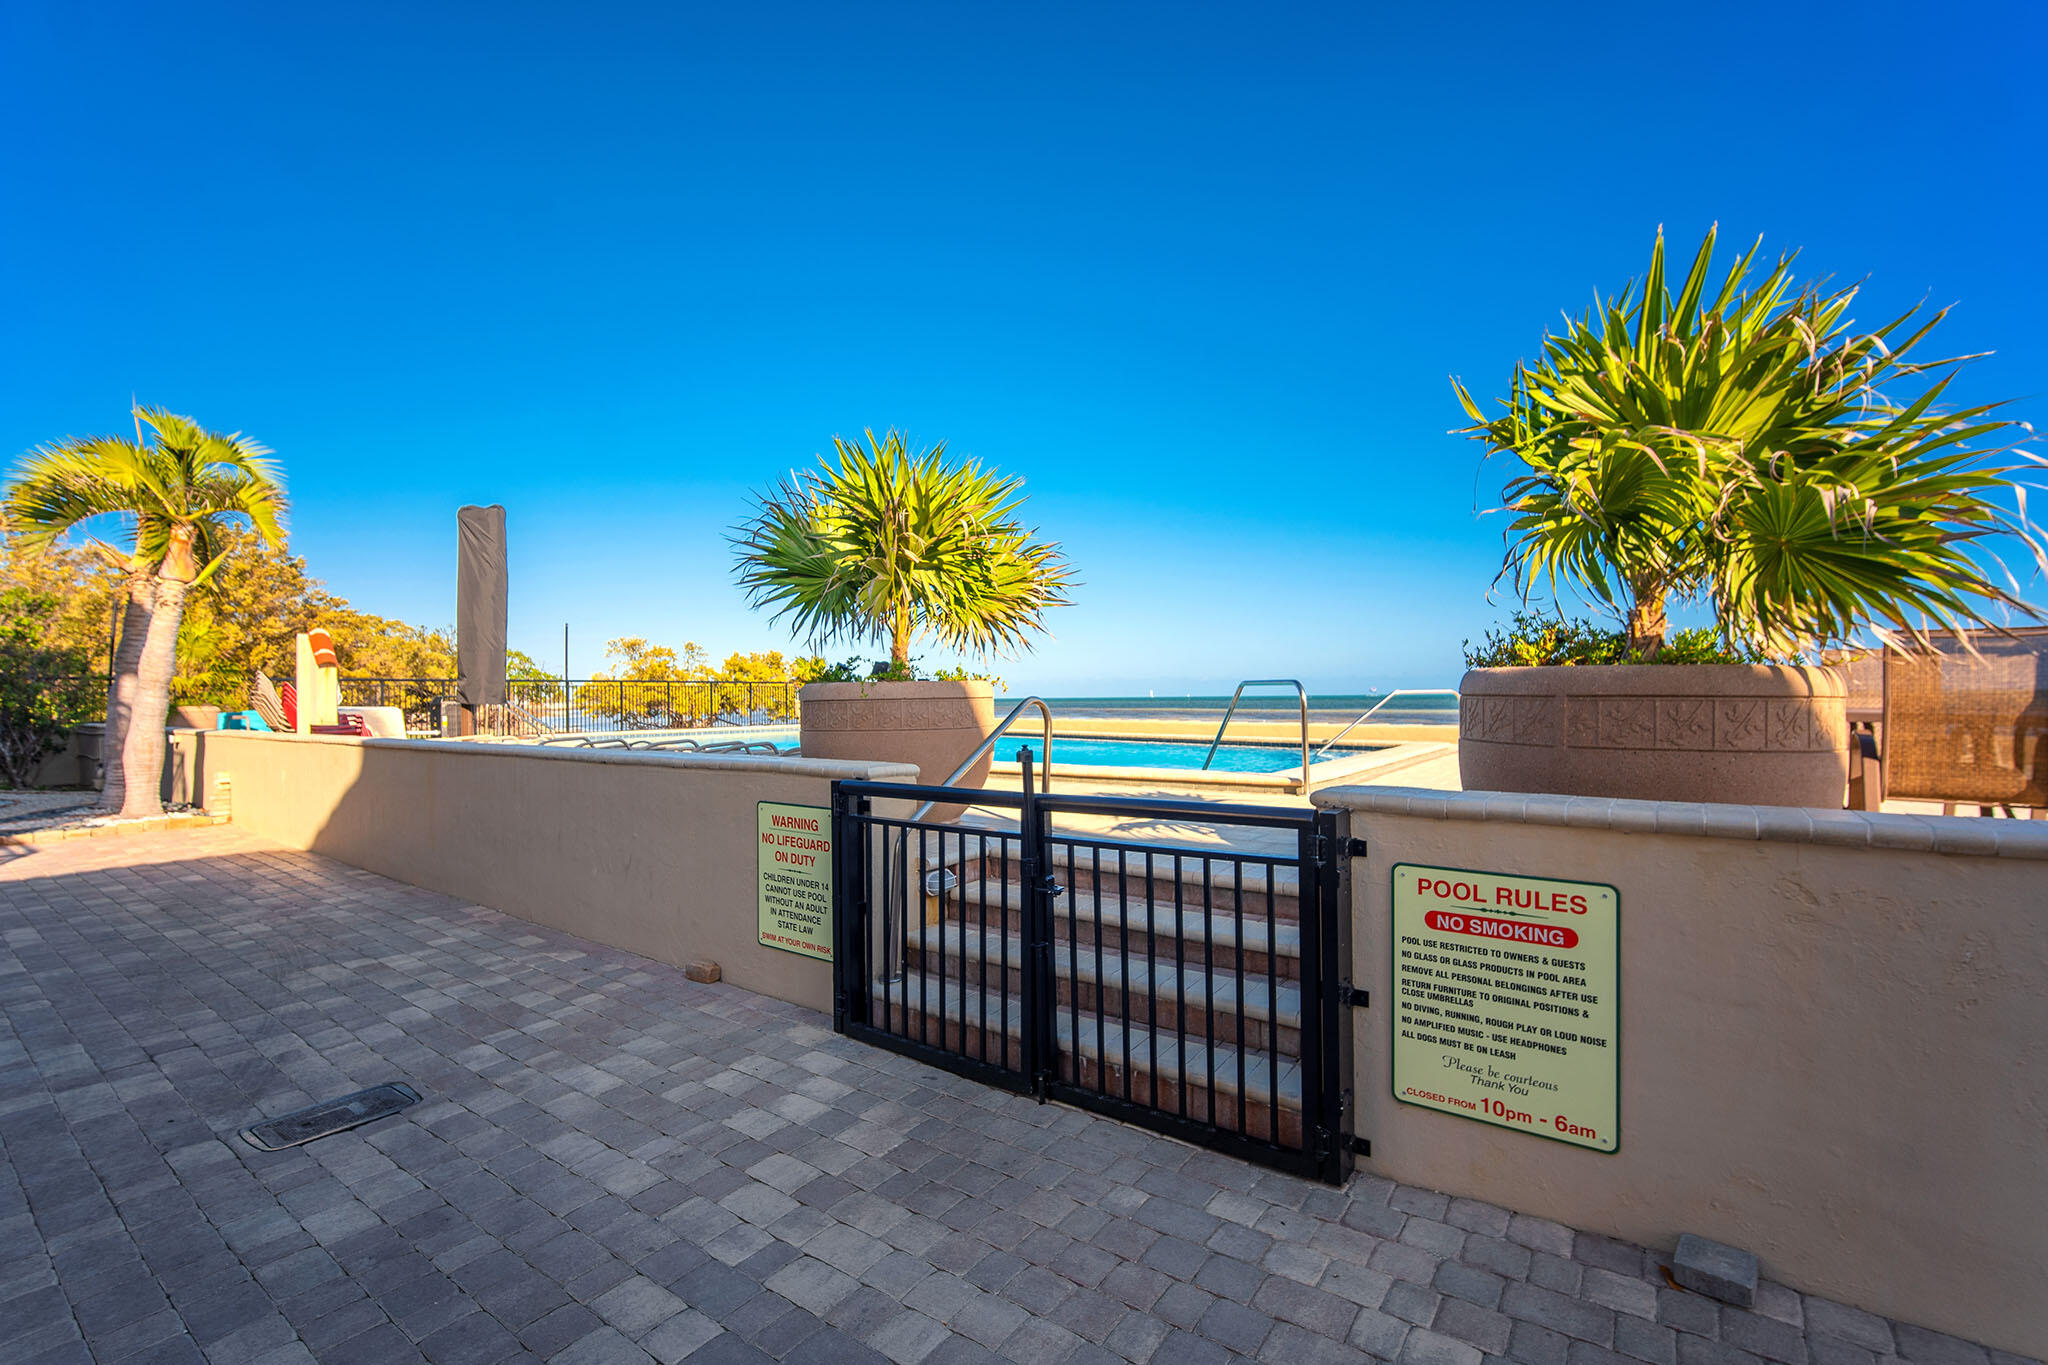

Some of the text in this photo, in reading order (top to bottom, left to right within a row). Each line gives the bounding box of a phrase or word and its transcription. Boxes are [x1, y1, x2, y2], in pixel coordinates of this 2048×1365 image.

[771, 815, 819, 832] WARNING
[762, 832, 831, 852] NO LIFEGUARD
[775, 850, 816, 867] ON DUTY
[763, 872, 795, 885] CHILDREN
[796, 878, 820, 890] UNDER
[765, 884, 827, 902] CANNOT USE POOL
[764, 894, 828, 914] WITHOUT AN ADULT
[1418, 878, 1588, 915] POOL RULES
[778, 909, 822, 926] ATTENDANCE
[778, 920, 814, 934] STATE LAW
[1436, 914, 1565, 945] NO SMOKING
[762, 932, 776, 941] SWIM
[784, 937, 800, 948] YOUR
[802, 942, 816, 951] OWN
[816, 944, 832, 954] RISK
[1402, 936, 1586, 971] POOL USE RESTRICTED TO OWNERS & GUESTS
[1402, 950, 1586, 987] NO GLASS OR GLASS PRODUCTS IN POOL AREA
[1402, 964, 1598, 1004] REMOVE ALL PERSONAL BELONGINGS AFTER USE
[1402, 978, 1589, 1018] RETURN FURNITURE TO ORIGINAL POSITIONS &
[1402, 988, 1474, 1008] CLOSE UMBRELLAS
[1402, 1002, 1607, 1048] NO DIVING, RUNNING, ROUGH PLAY OR LOUD NOISE
[1402, 1016, 1412, 1024] NO
[1414, 1018, 1456, 1033] AMPLIFIED
[1458, 1026, 1484, 1038] MUSIC
[1492, 1033, 1508, 1044] USE
[1510, 1037, 1568, 1056] HEADPHONES
[1402, 1030, 1516, 1060] ALL DOGS MUST BE ON LEASH
[1442, 1054, 1560, 1092] Please be courteous
[1470, 1074, 1529, 1096] Thank You
[1406, 1086, 1446, 1103] CLOSED
[1448, 1097, 1477, 1111] FROM
[1480, 1097, 1532, 1124] 10pm
[1554, 1115, 1596, 1140] 6am
